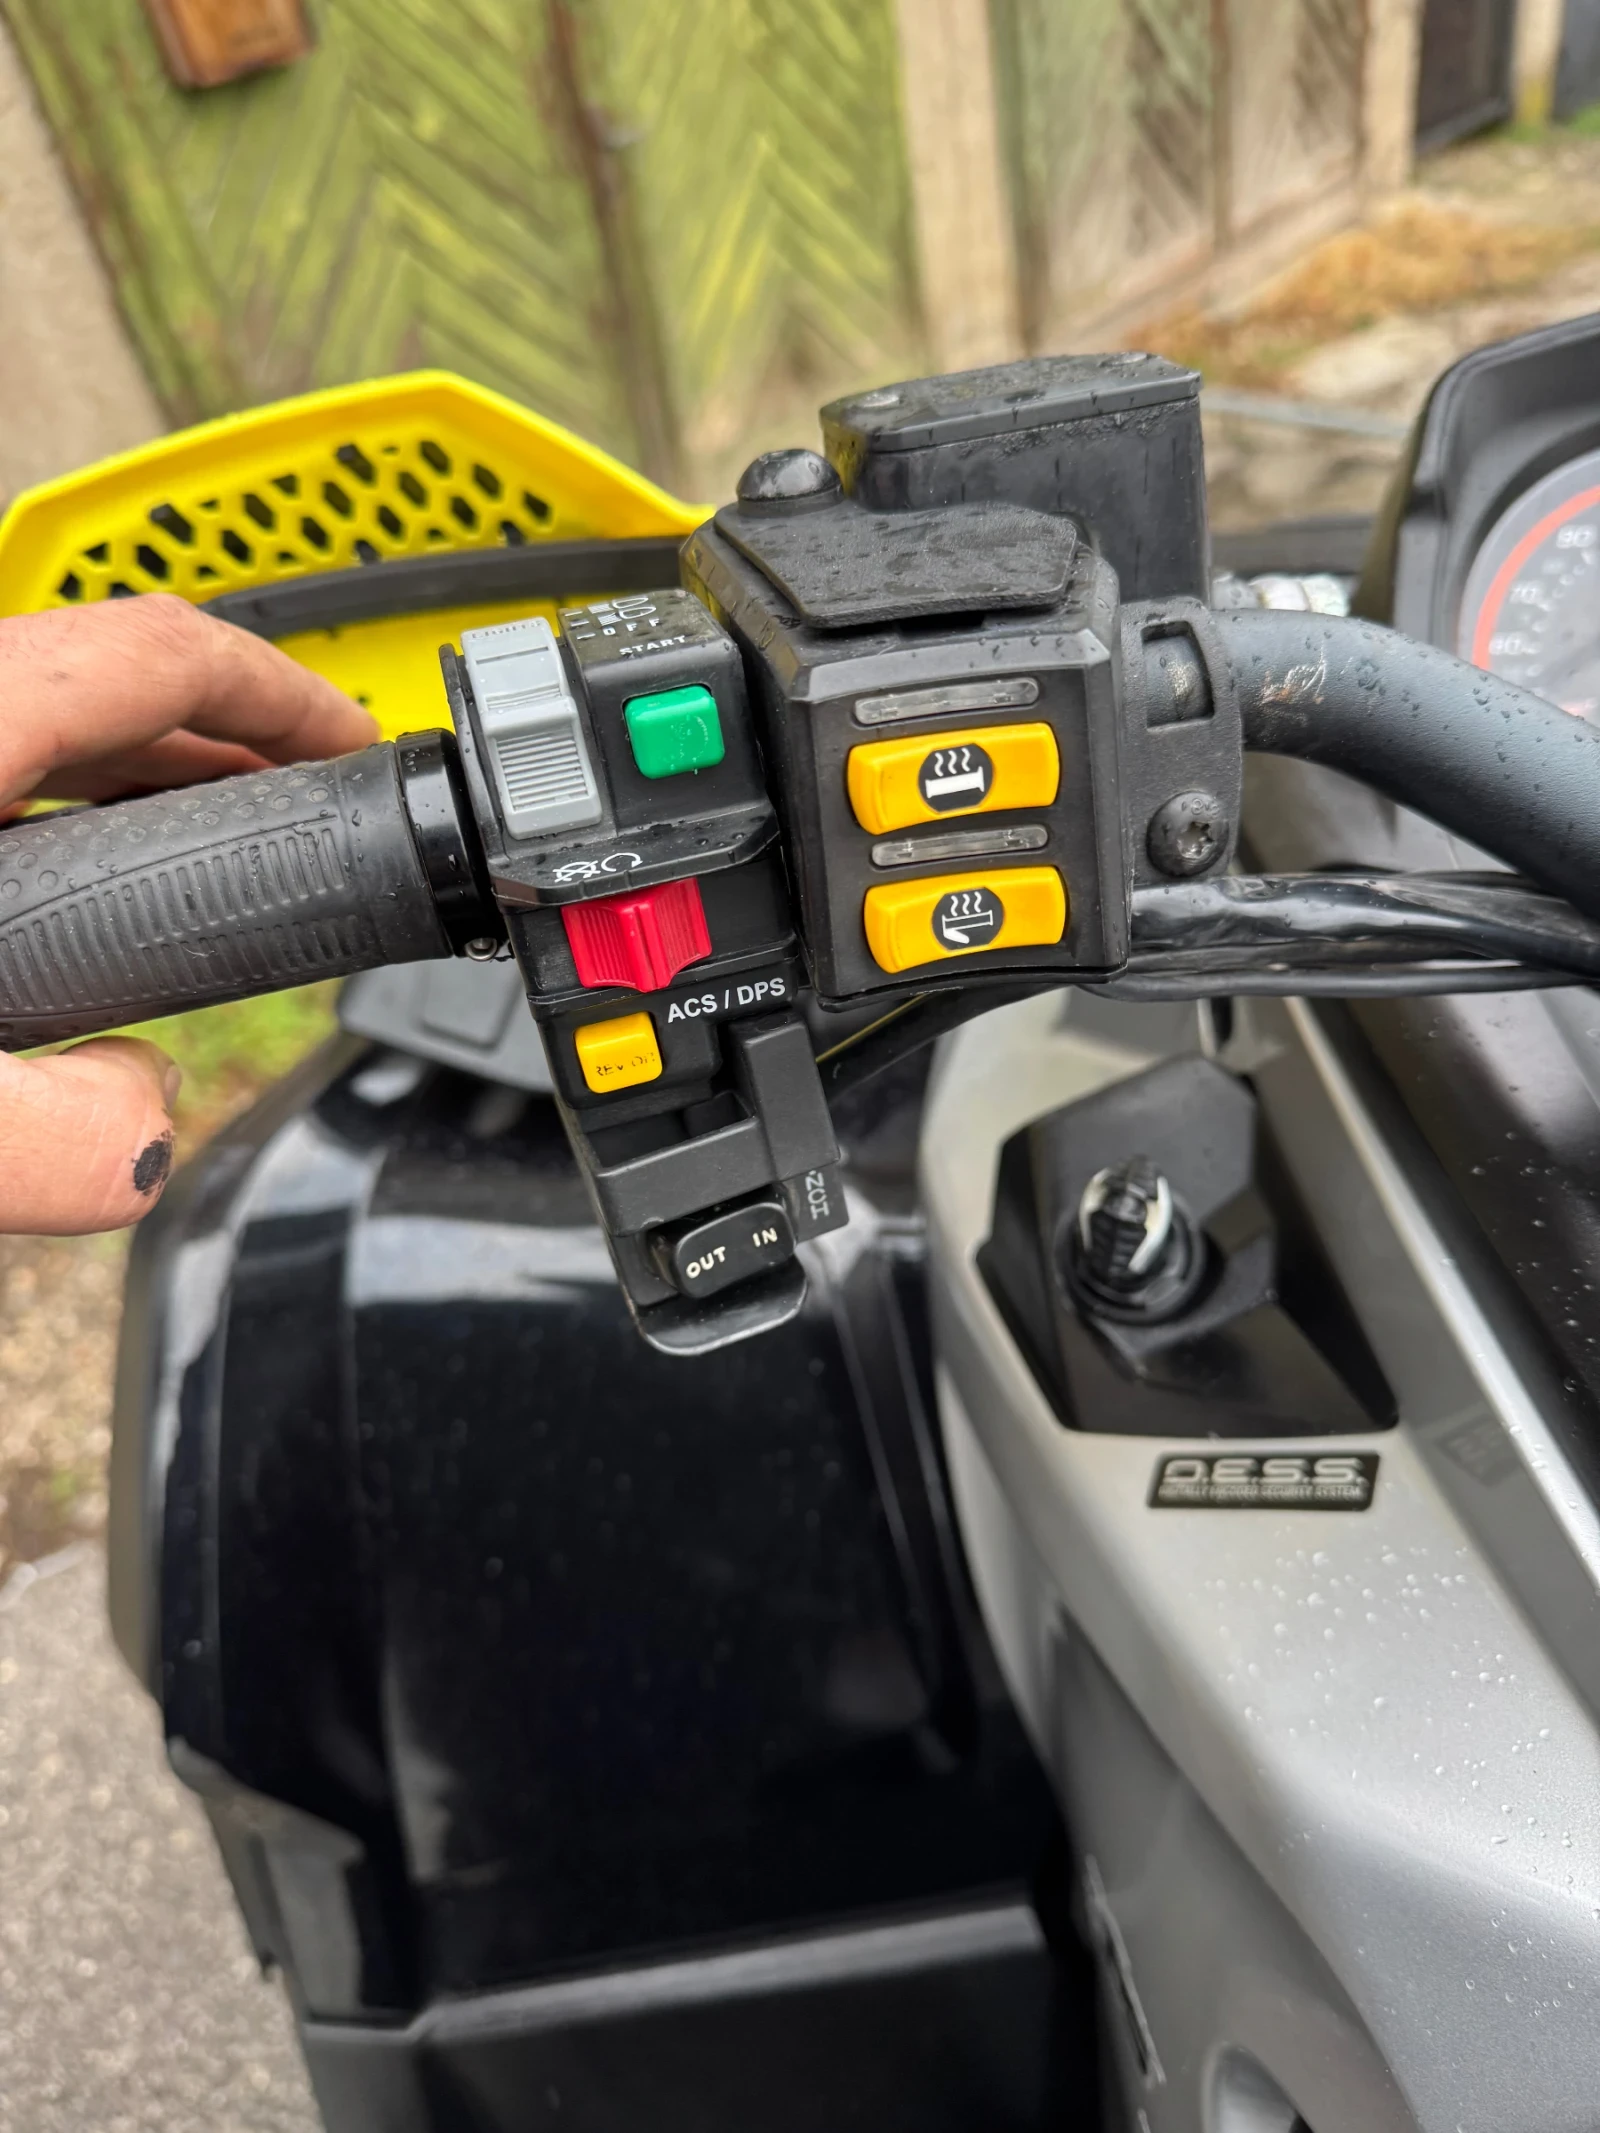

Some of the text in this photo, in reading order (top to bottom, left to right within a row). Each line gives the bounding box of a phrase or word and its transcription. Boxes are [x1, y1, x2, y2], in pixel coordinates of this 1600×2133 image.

[602, 618, 662, 637] OFF
[619, 634, 686, 656] START
[667, 977, 786, 1024] ACS / DPS
[804, 1169, 830, 1221] NCH
[685, 1227, 778, 1279] OUT IN
